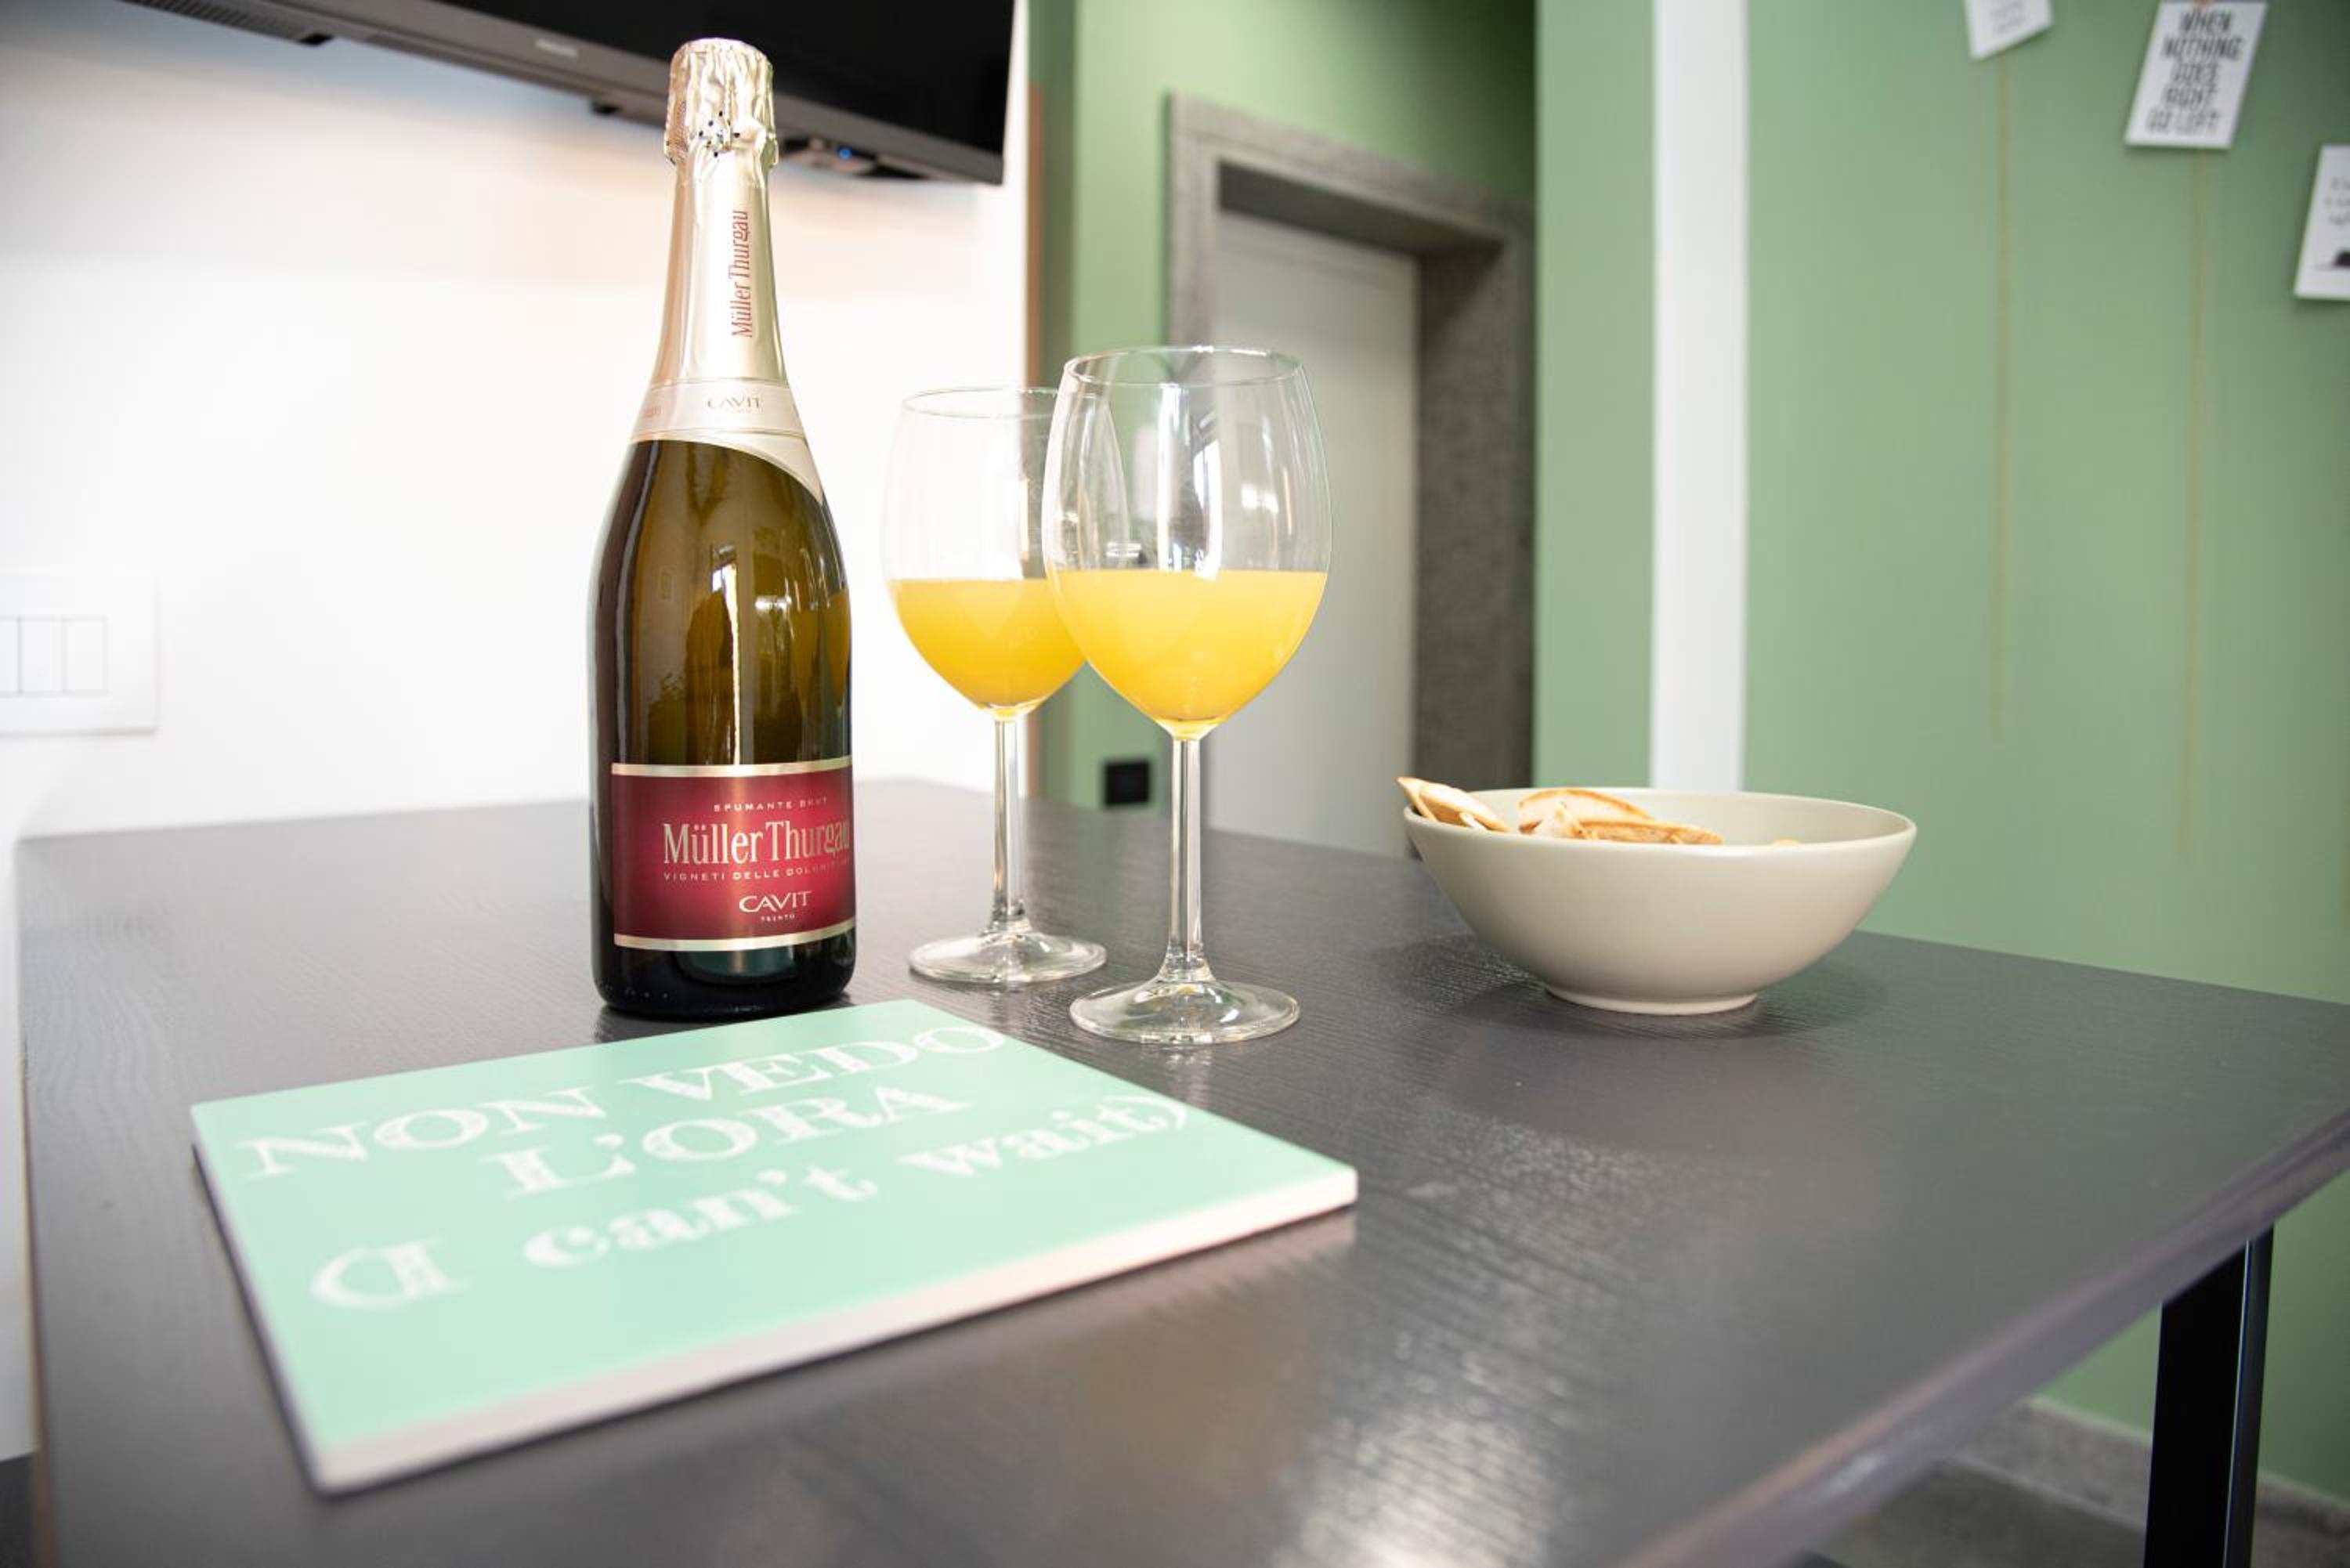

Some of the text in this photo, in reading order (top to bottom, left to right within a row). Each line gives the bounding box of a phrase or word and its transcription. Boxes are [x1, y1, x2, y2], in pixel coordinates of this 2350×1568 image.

[2178, 10, 2232, 32] WHEN
[2162, 35, 2243, 60] NOTHING
[728, 210, 753, 338] Müller Thurgau
[707, 395, 761, 410] CAVIT
[714, 800, 793, 813] SPUMANTE
[663, 818, 850, 865] Müller Thurgau
[663, 872, 725, 881] VIGNETI
[732, 869, 780, 880] DELLE
[738, 890, 812, 913] CAVIT
[235, 1026, 1006, 1180] NON VEDO
[895, 1094, 1189, 1177] wait)
